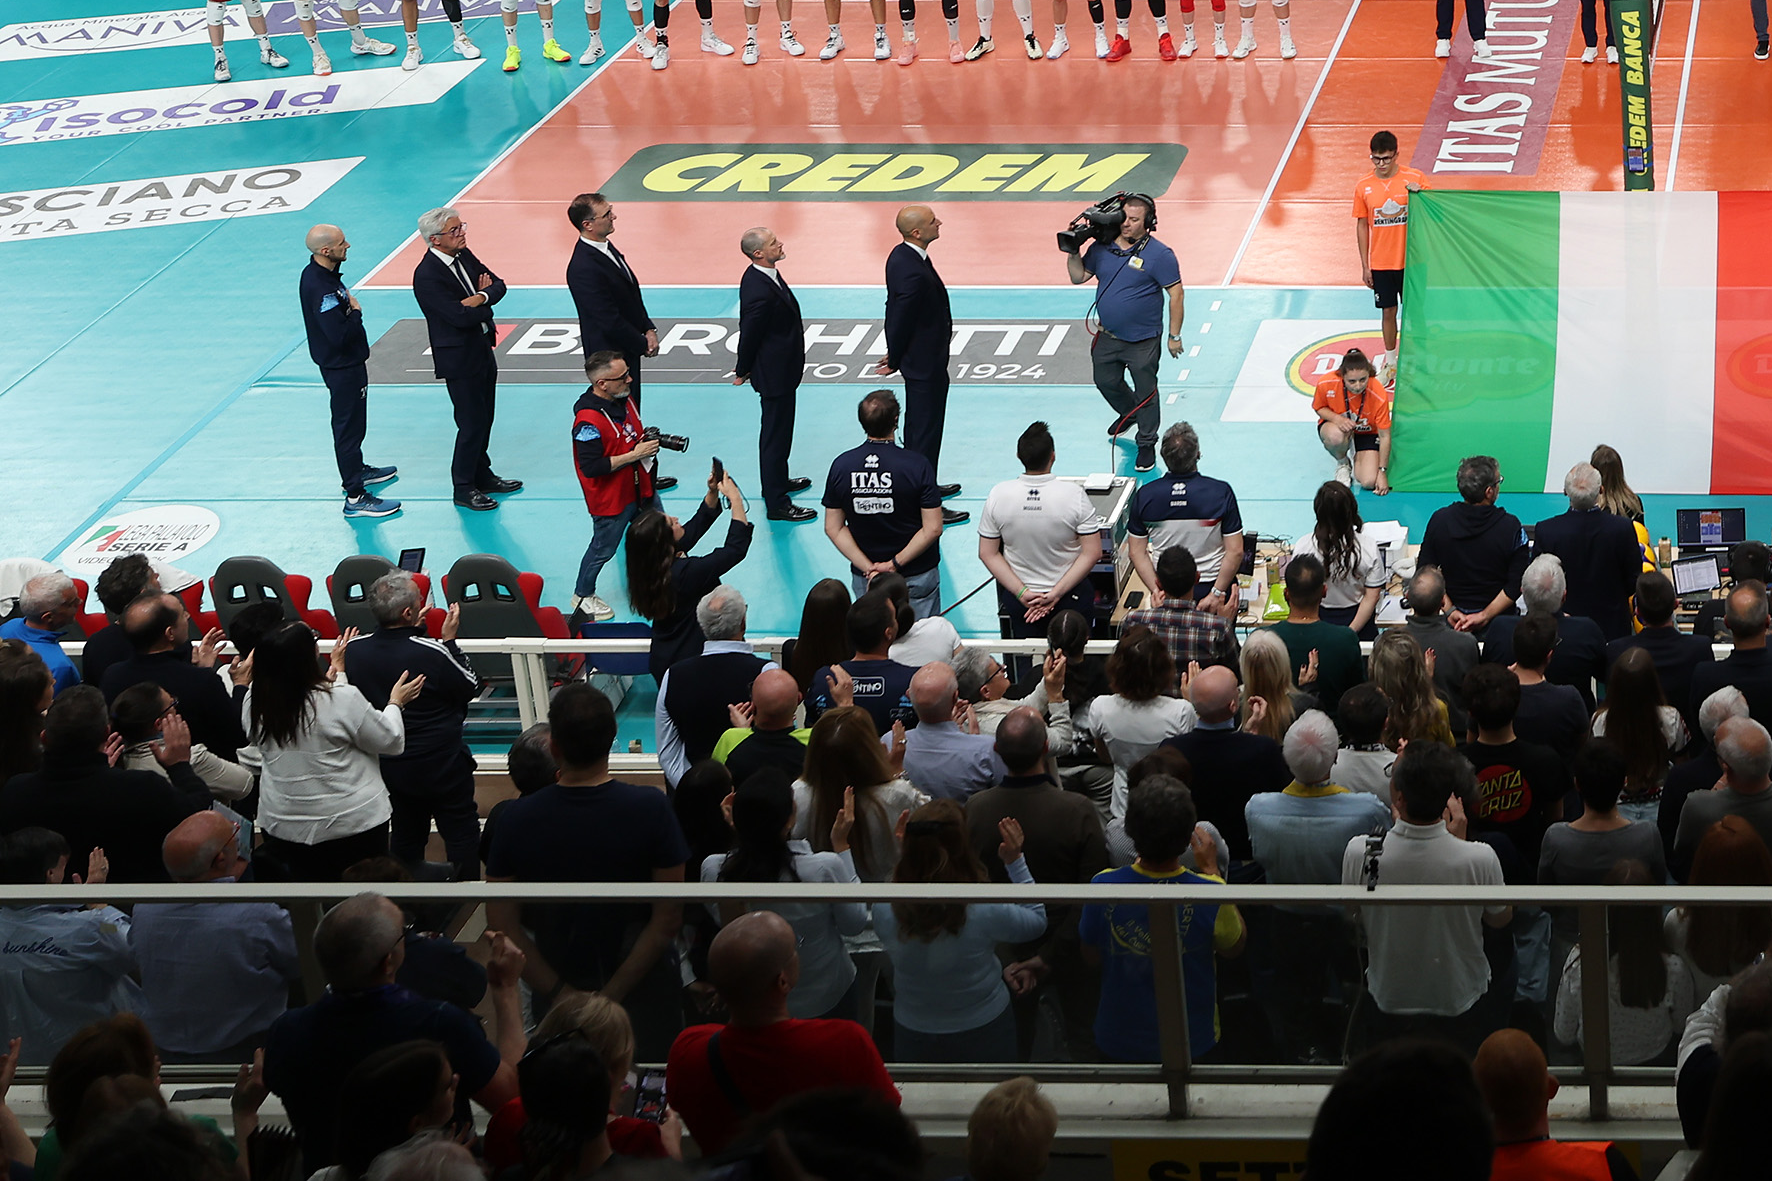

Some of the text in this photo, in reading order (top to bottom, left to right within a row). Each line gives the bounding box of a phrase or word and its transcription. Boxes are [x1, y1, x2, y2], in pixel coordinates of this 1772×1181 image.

[1621, 10, 1645, 86] BANCA
[35, 84, 341, 133] isocold
[31, 107, 329, 142] YOUR COOL PARTNER.
[1432, 92, 1534, 174] ITAS
[643, 152, 1152, 193] CREDEM
[104, 196, 291, 226] SECCA
[956, 363, 1046, 380] 1924
[851, 472, 893, 489] ITAS
[856, 499, 891, 511] TRENTINO
[107, 542, 190, 552] SERIE A
[1478, 769, 1522, 797] ANTA
[1480, 790, 1523, 818] CRUZ
